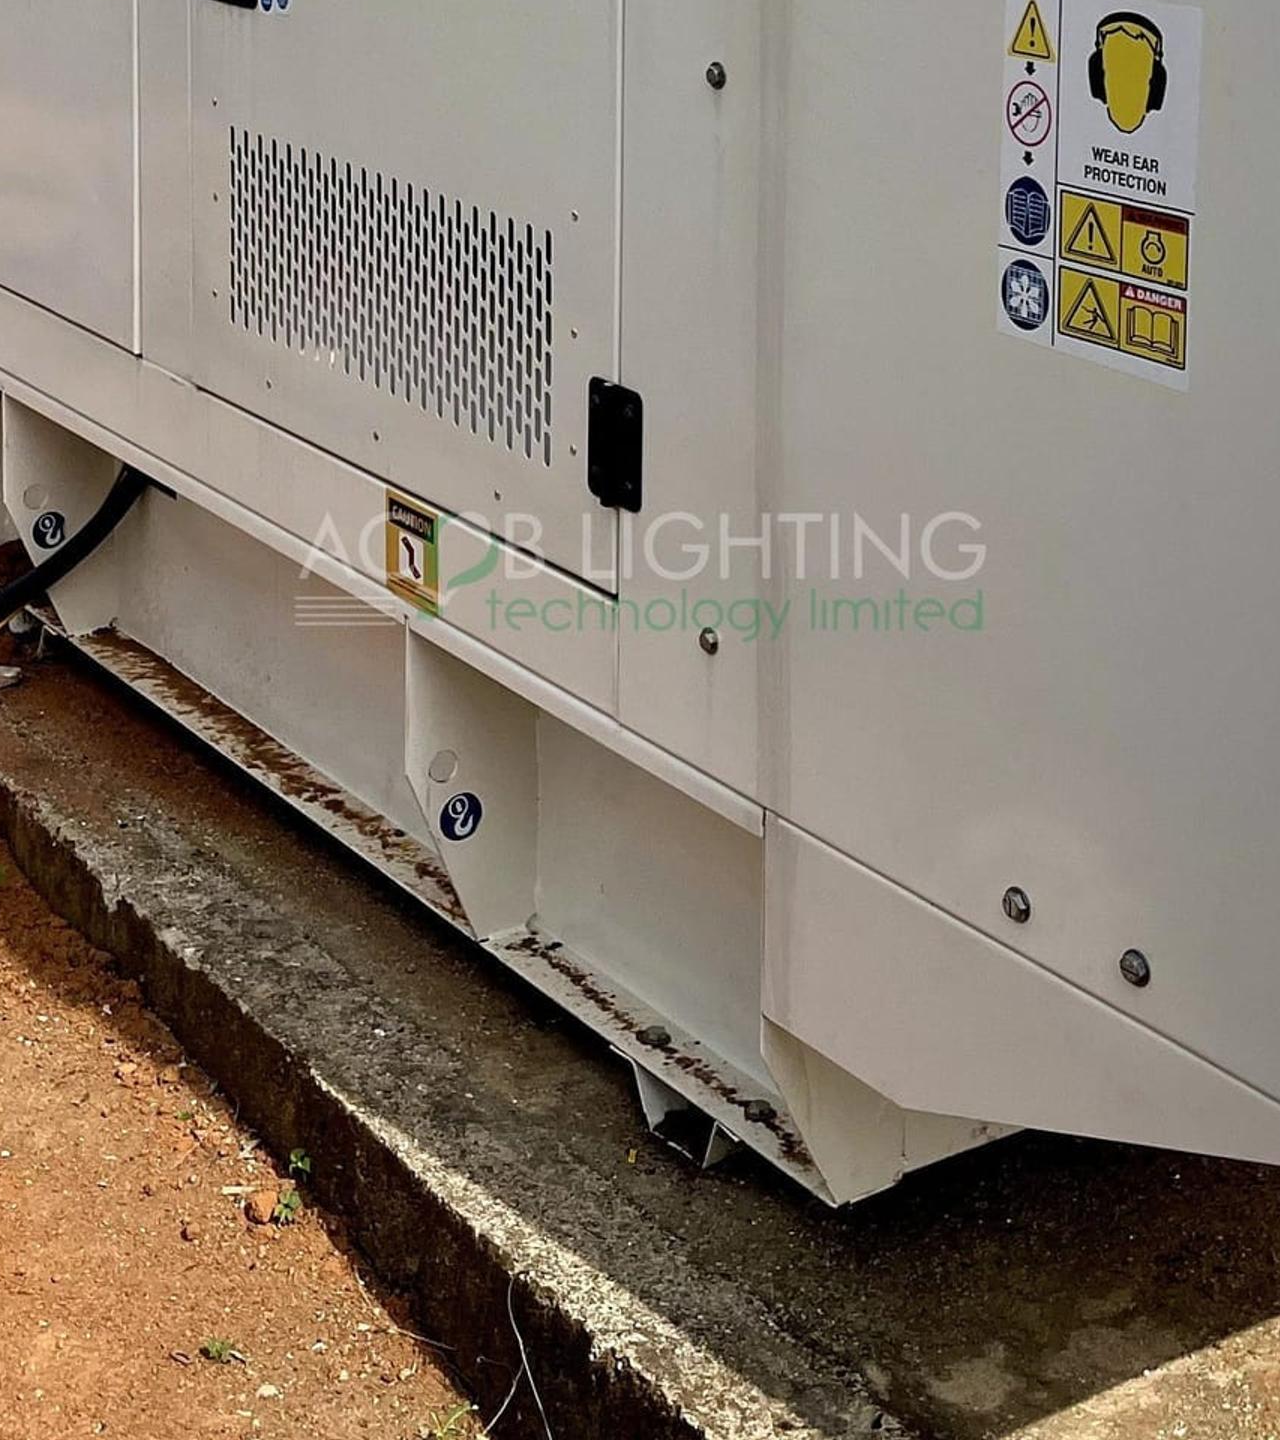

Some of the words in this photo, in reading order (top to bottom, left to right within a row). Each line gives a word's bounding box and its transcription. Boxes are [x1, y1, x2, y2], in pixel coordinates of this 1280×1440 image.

[1091, 146, 1129, 167] WEAR
[1133, 155, 1159, 173] EAR
[1084, 164, 1166, 196] PROTECTION
[1142, 263, 1164, 277] AUTO
[1136, 289, 1182, 310] DANGER
[392, 505, 432, 537] CAUTION
